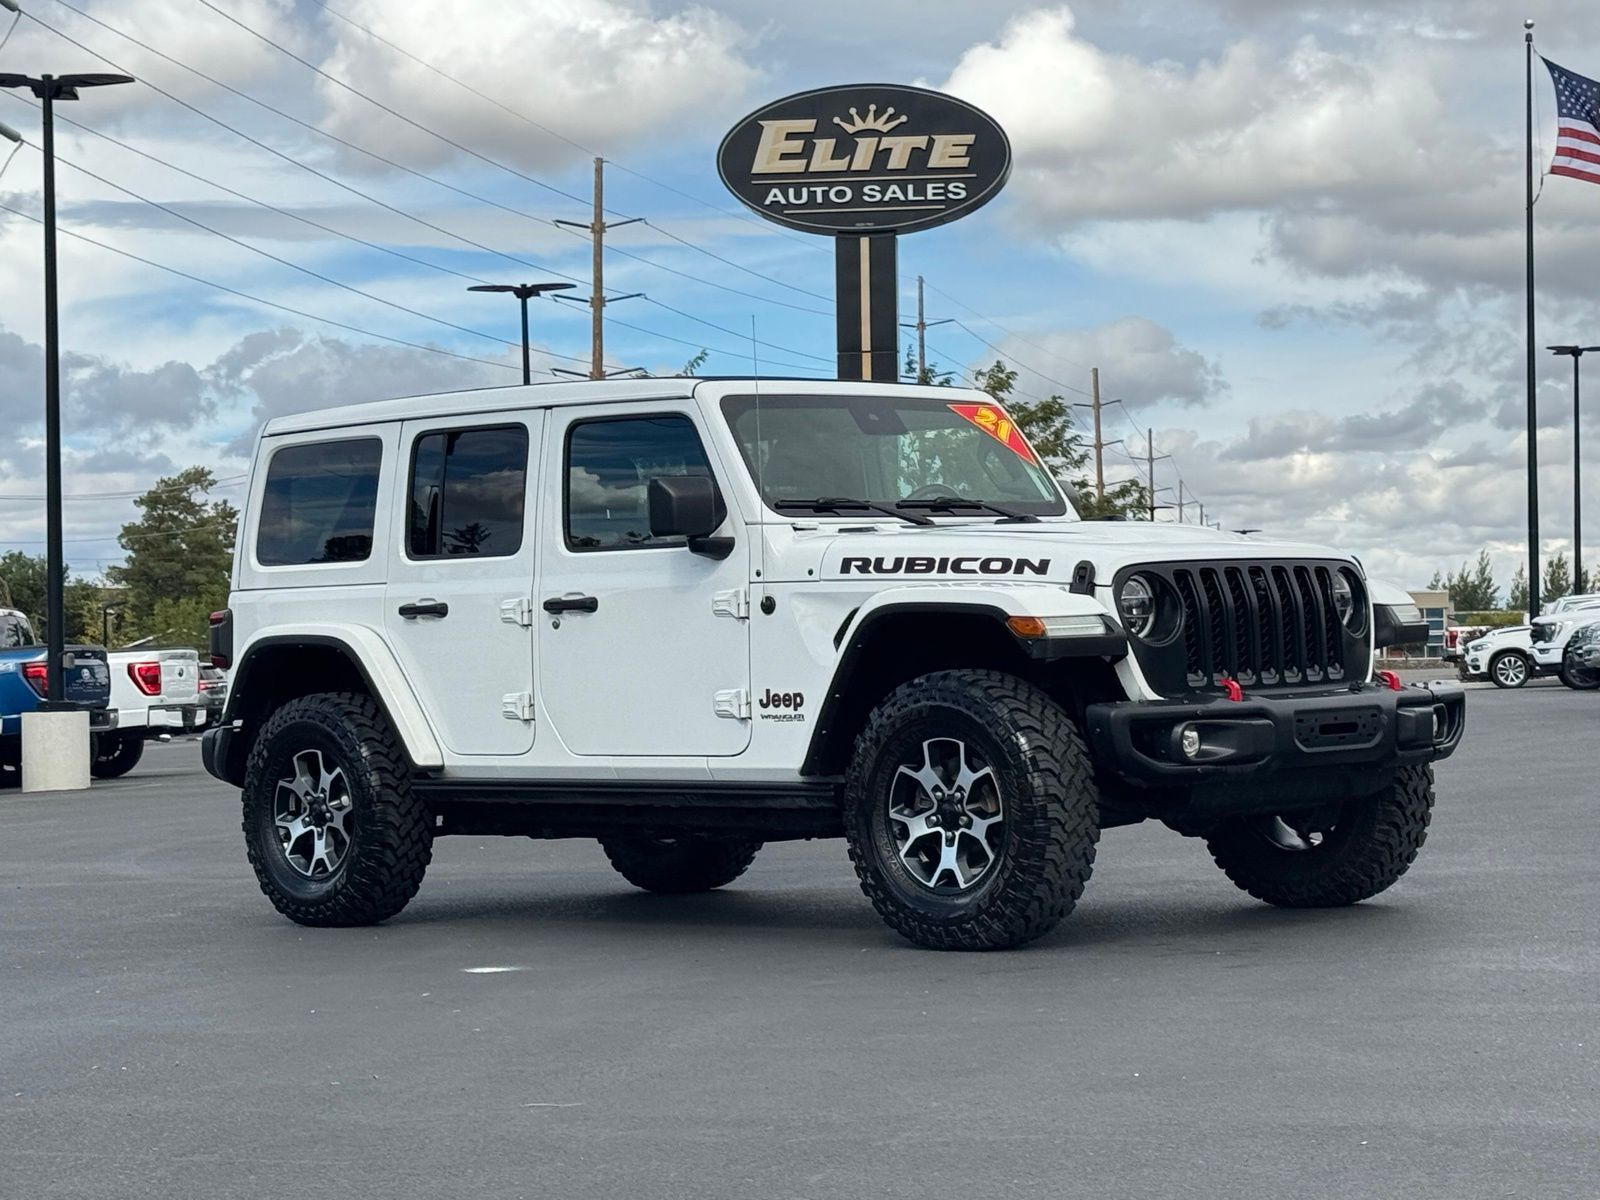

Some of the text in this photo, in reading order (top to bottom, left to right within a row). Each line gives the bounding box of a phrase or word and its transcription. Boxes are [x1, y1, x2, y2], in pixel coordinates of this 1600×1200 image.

[751, 119, 977, 174] ELITE
[764, 182, 967, 205] AUTO SALES
[973, 406, 1012, 443] 21
[840, 557, 1051, 575] RUBICON
[759, 688, 804, 711] Jeep
